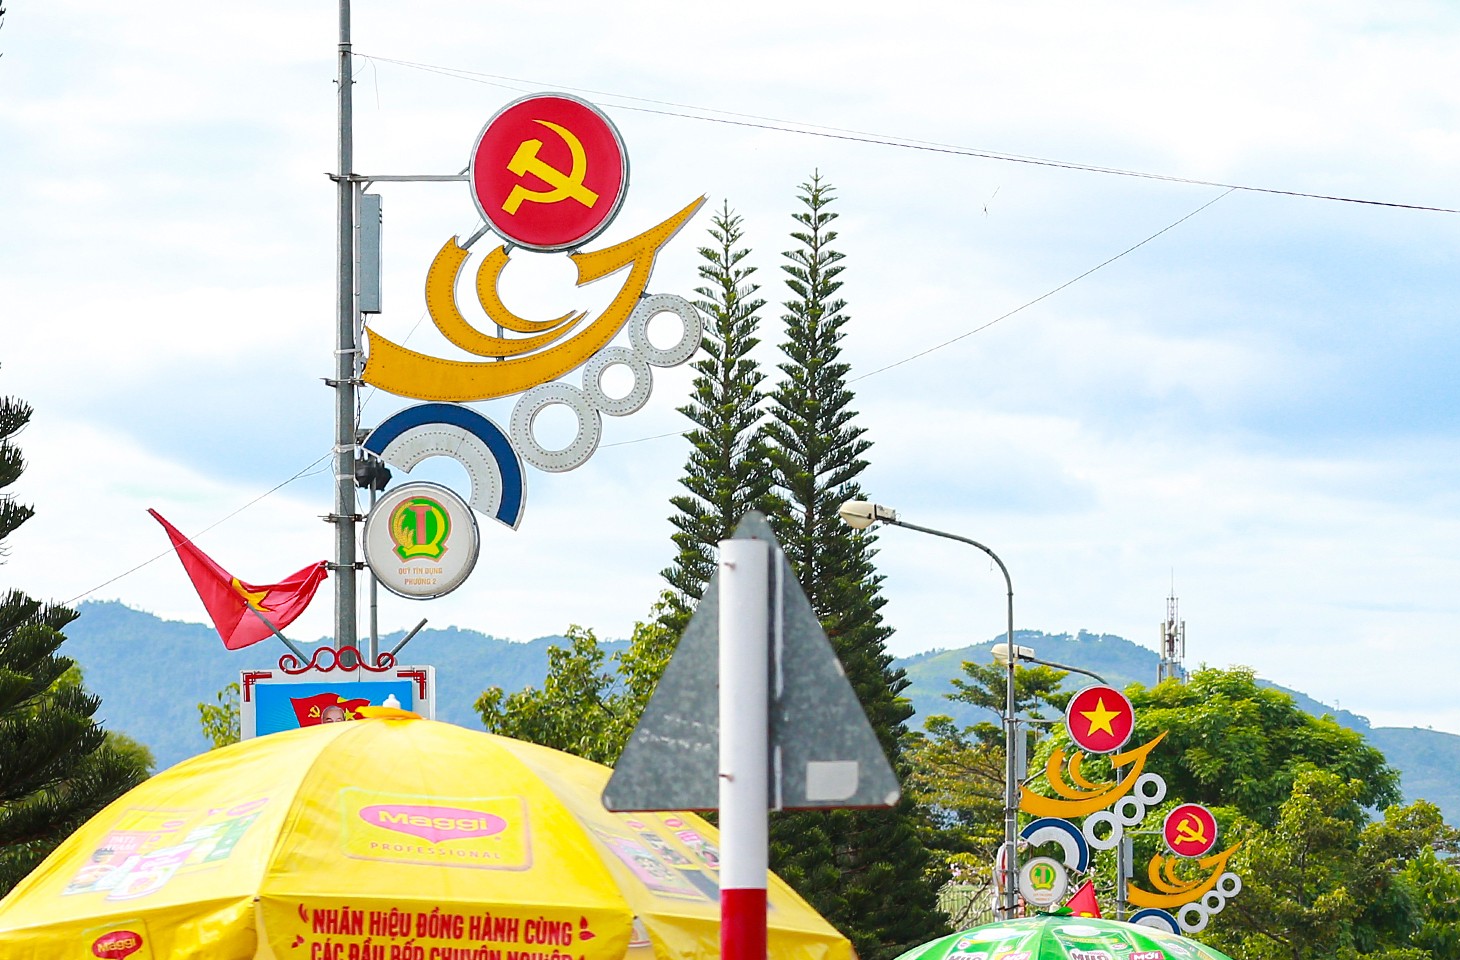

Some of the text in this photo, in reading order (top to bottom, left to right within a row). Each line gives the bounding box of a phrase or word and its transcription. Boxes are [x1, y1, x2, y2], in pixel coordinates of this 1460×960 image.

[378, 810, 488, 832] Maggi
[370, 841, 501, 860] PROFESSIONAL
[312, 905, 364, 936] NHÃN
[416, 906, 464, 939] ĐỒNG
[469, 911, 519, 943] HÀNH
[524, 916, 573, 947] CÙNG
[96, 937, 138, 953] Maggi
[1133, 951, 1159, 960] MỚI
